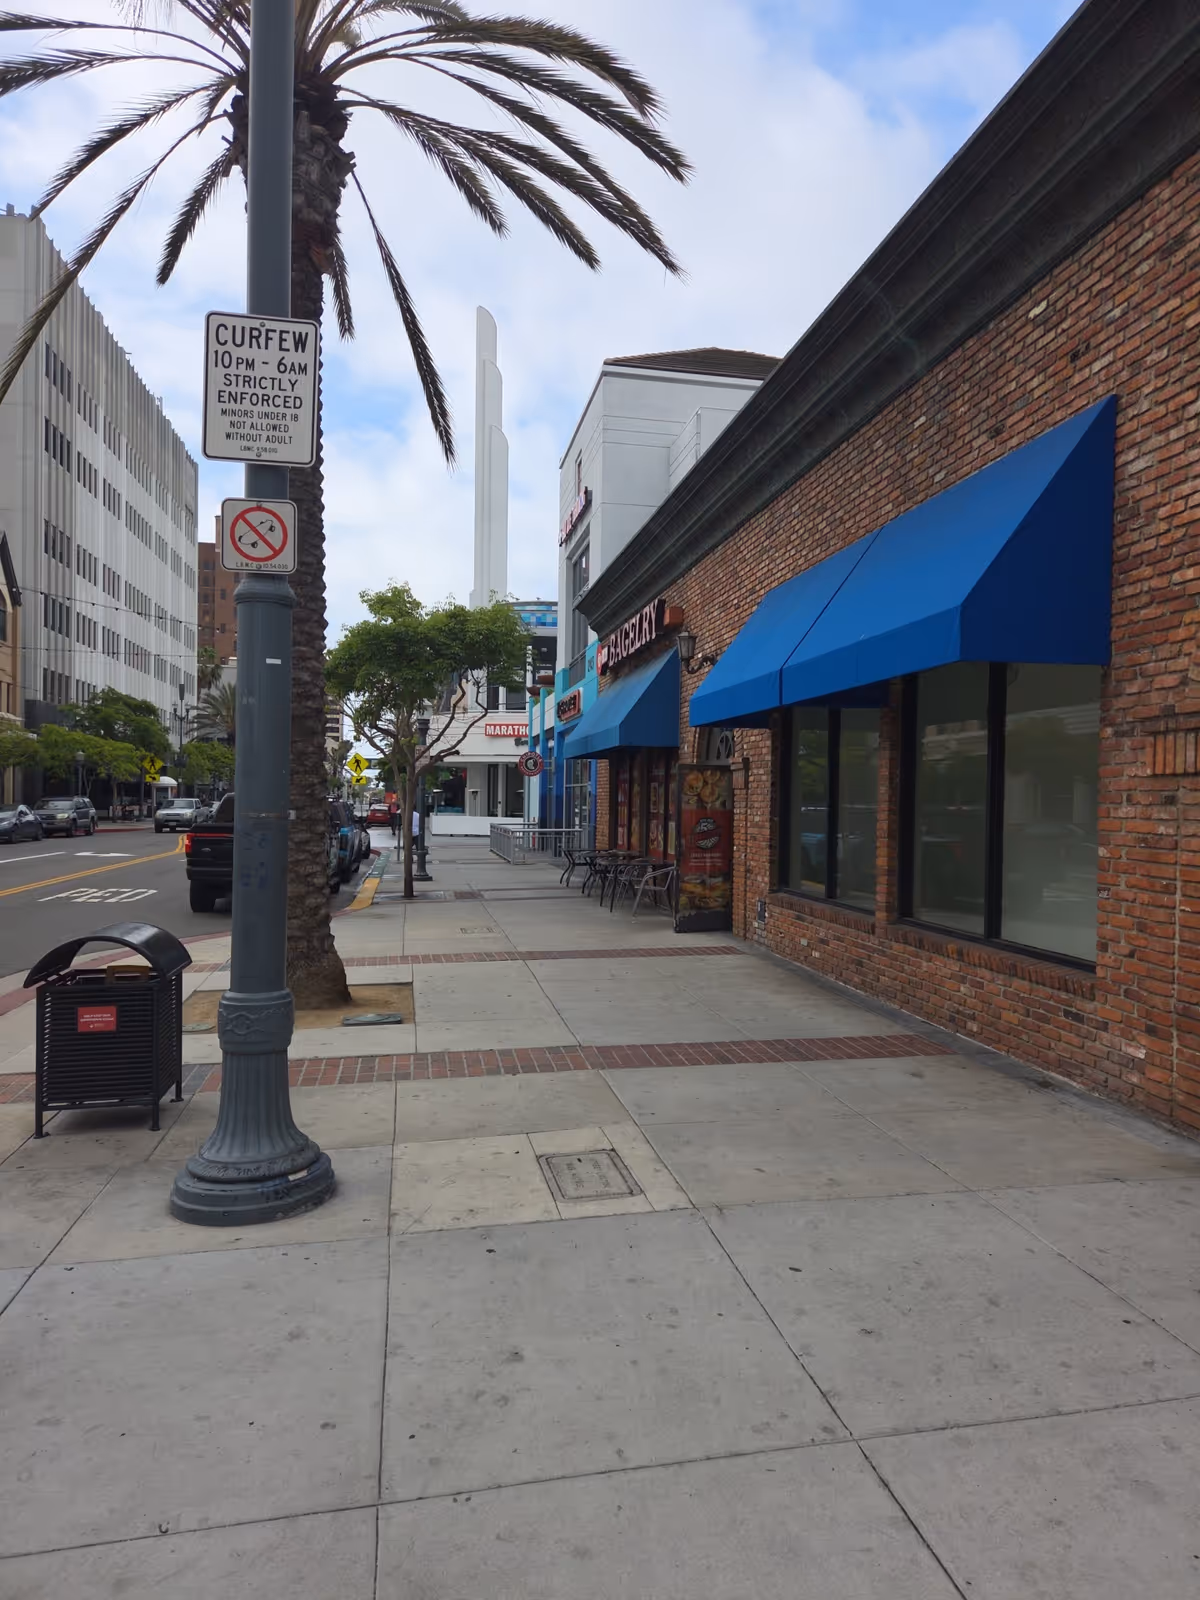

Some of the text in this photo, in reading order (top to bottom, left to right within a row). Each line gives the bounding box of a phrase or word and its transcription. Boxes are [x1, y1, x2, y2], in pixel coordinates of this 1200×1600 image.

[215, 323, 309, 353] CURFEW
[277, 356, 308, 376] 6AM
[223, 373, 299, 393] STRICTLY
[217, 389, 303, 410] ENFORCED
[220, 407, 299, 422] MINORS UNDER 18
[229, 420, 290, 433] NOT ALLOWED
[225, 431, 293, 445] WITHOUT ADULT
[608, 598, 659, 667] BAGELRY
[37, 888, 158, 903] PED
